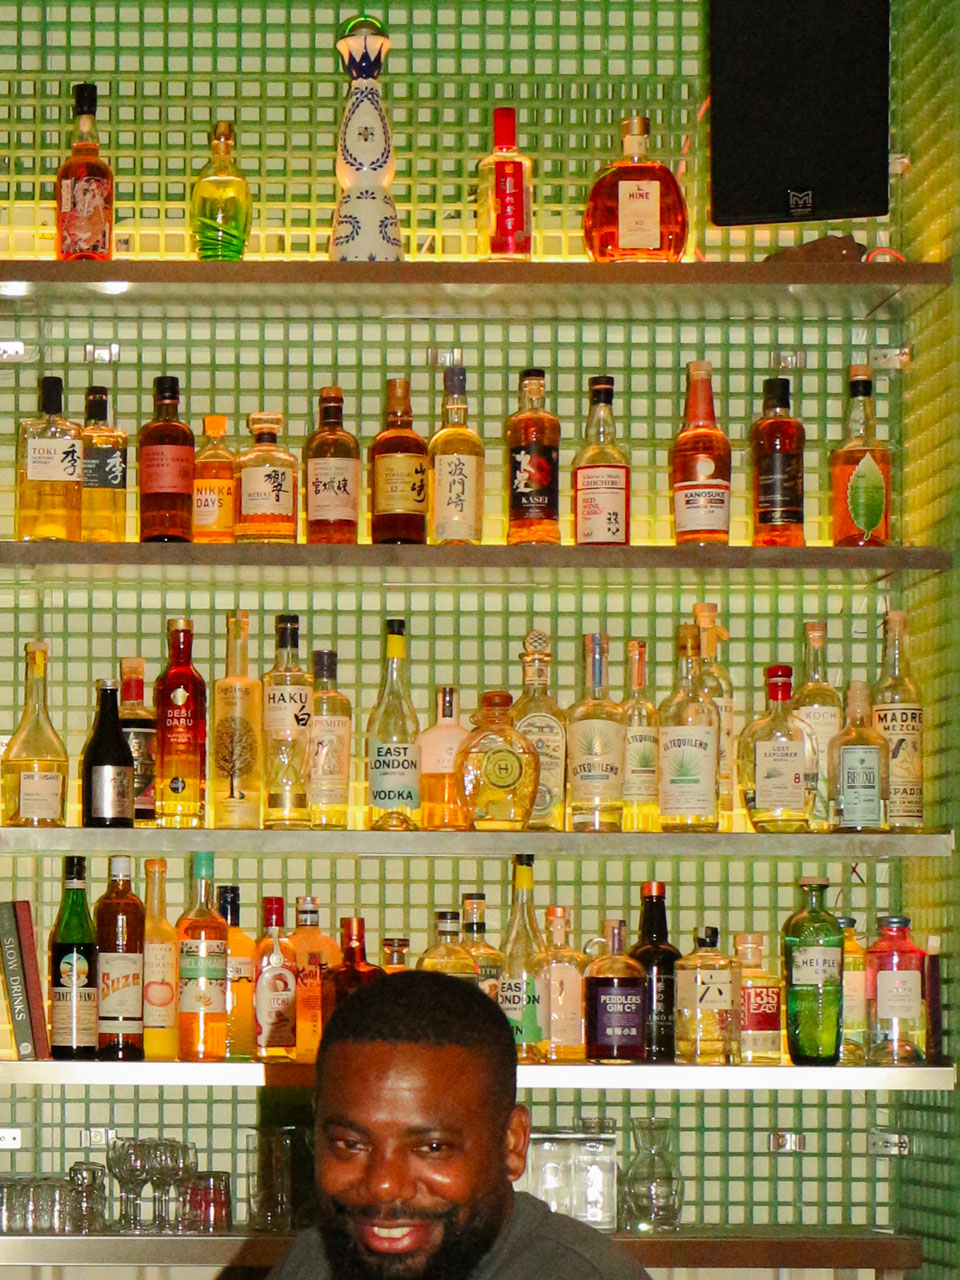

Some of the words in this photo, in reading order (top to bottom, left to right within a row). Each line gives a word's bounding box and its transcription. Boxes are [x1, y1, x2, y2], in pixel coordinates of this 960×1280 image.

[628, 192, 650, 200] HINE
[32, 447, 57, 455] TOKI
[196, 486, 232, 496] NIKKA
[684, 491, 726, 499] KANOSUKE
[196, 498, 224, 508] DAYS
[521, 496, 549, 504] KASEI
[268, 692, 308, 705] HAKU
[167, 709, 191, 718] DESI
[805, 711, 837, 720] KOCH
[877, 711, 923, 724] MADRE
[166, 718, 193, 727] DARU
[377, 747, 409, 757] EAST
[370, 759, 418, 770] LONDON
[793, 773, 801, 784] 8
[372, 790, 414, 801] VODKA
[4, 937, 20, 971] SLOW
[101, 972, 141, 1001] Suze
[500, 981, 530, 992] EAST
[9, 975, 26, 1021] DRINKS
[600, 994, 641, 1004] PEDDLERS
[746, 988, 778, 1005] 135
[606, 1003, 624, 1013] GIN
[749, 1003, 777, 1013] EAST
[511, 1025, 524, 1036] IN
